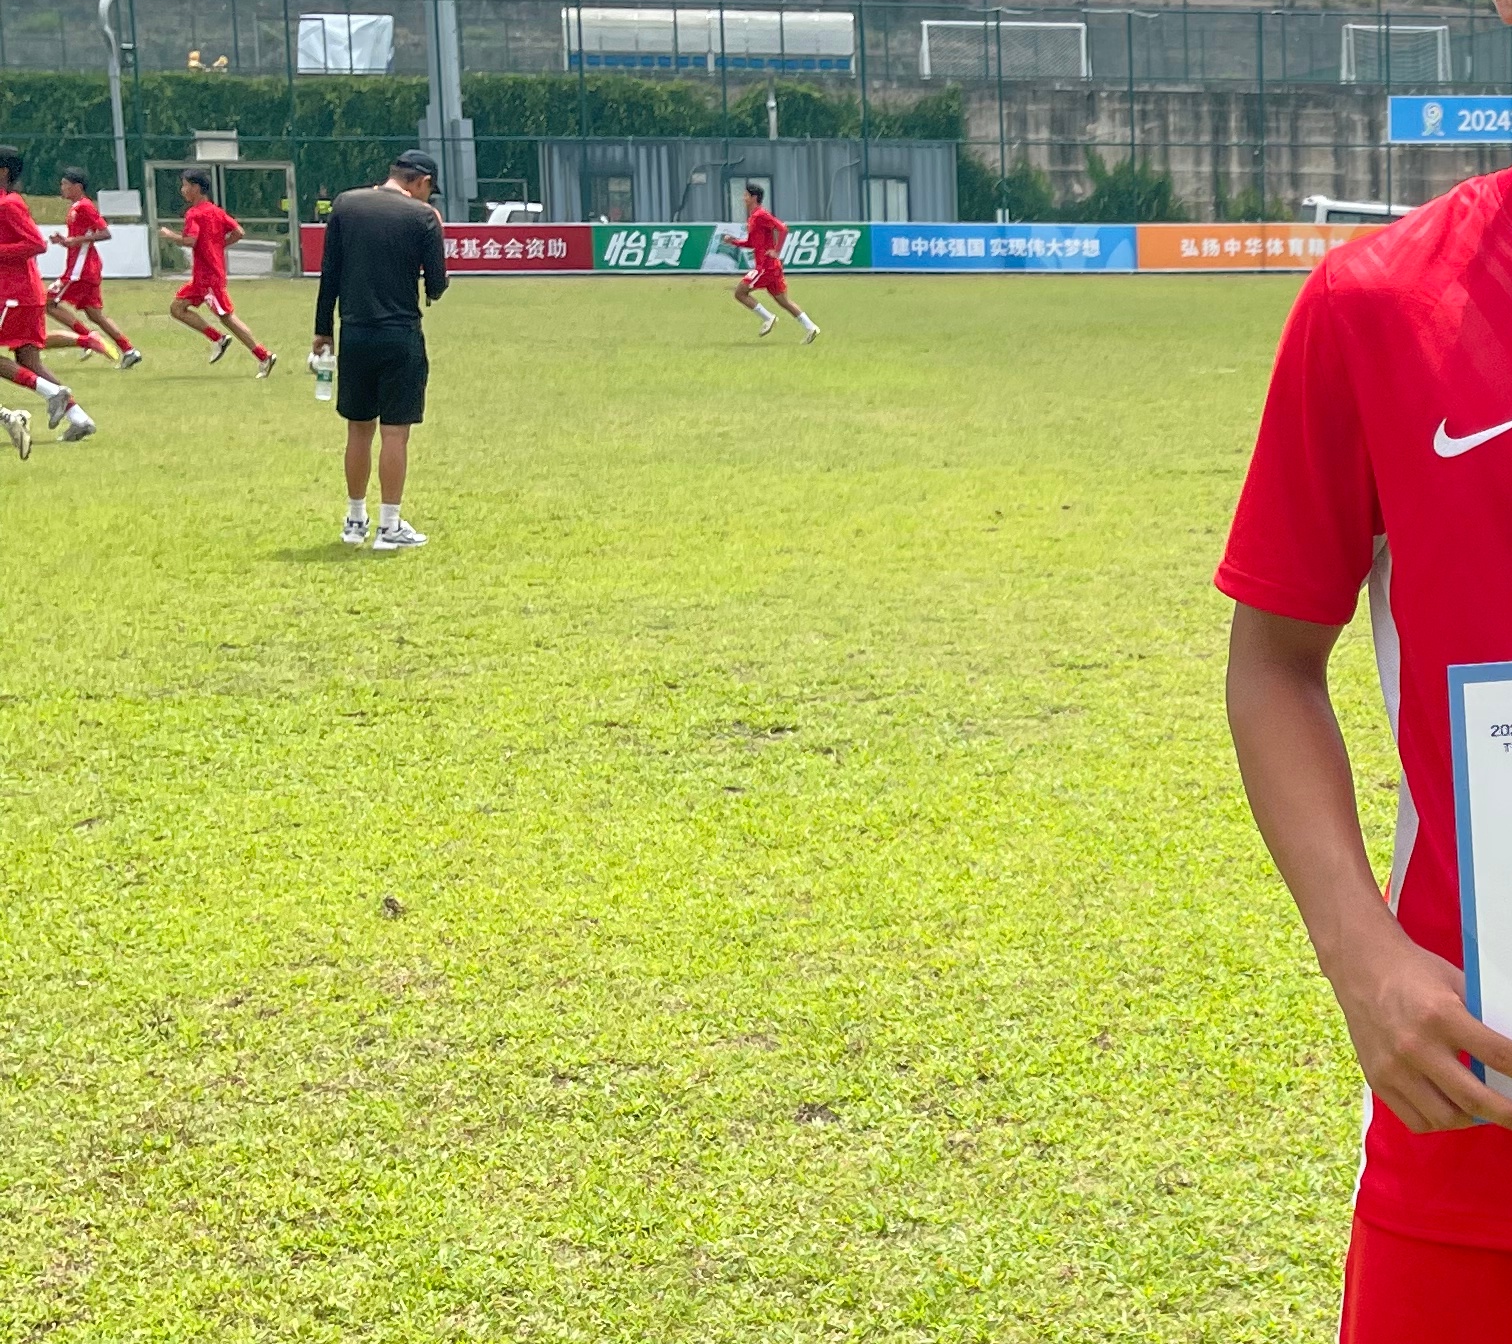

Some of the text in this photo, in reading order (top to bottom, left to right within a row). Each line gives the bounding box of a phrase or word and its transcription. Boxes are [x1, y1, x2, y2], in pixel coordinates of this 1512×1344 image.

[989, 237, 1100, 258] 实现伟大梦想
